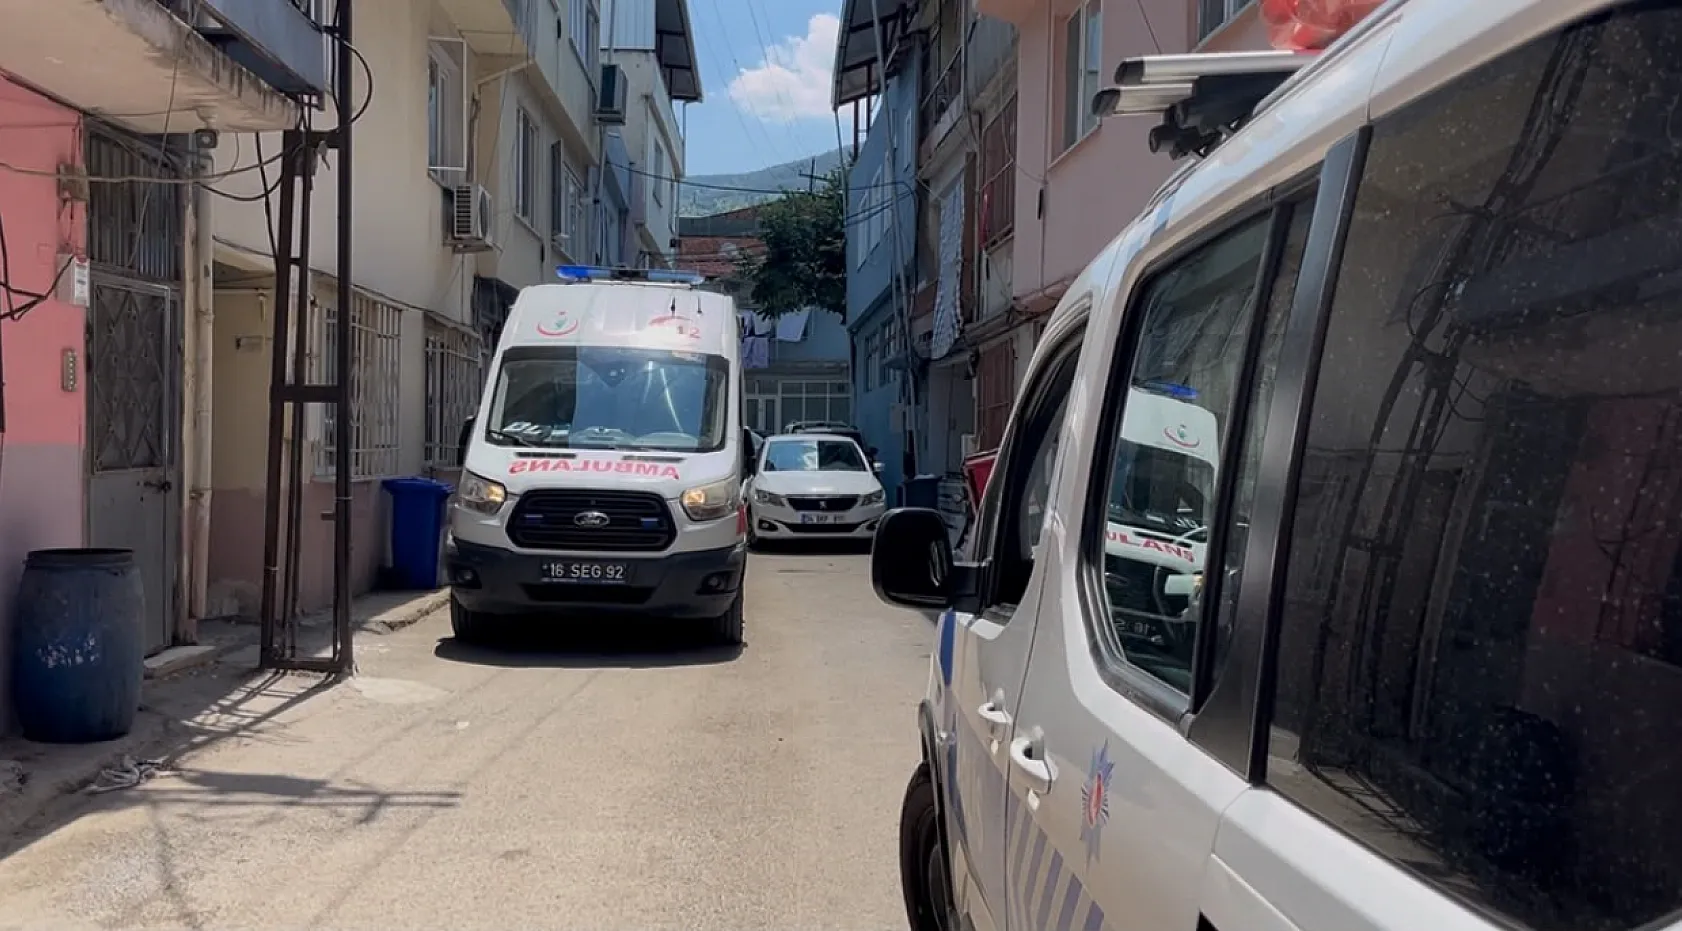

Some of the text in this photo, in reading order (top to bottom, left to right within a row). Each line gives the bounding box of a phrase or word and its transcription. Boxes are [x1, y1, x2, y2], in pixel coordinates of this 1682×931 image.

[550, 562, 623, 578] 16 SEG 92
